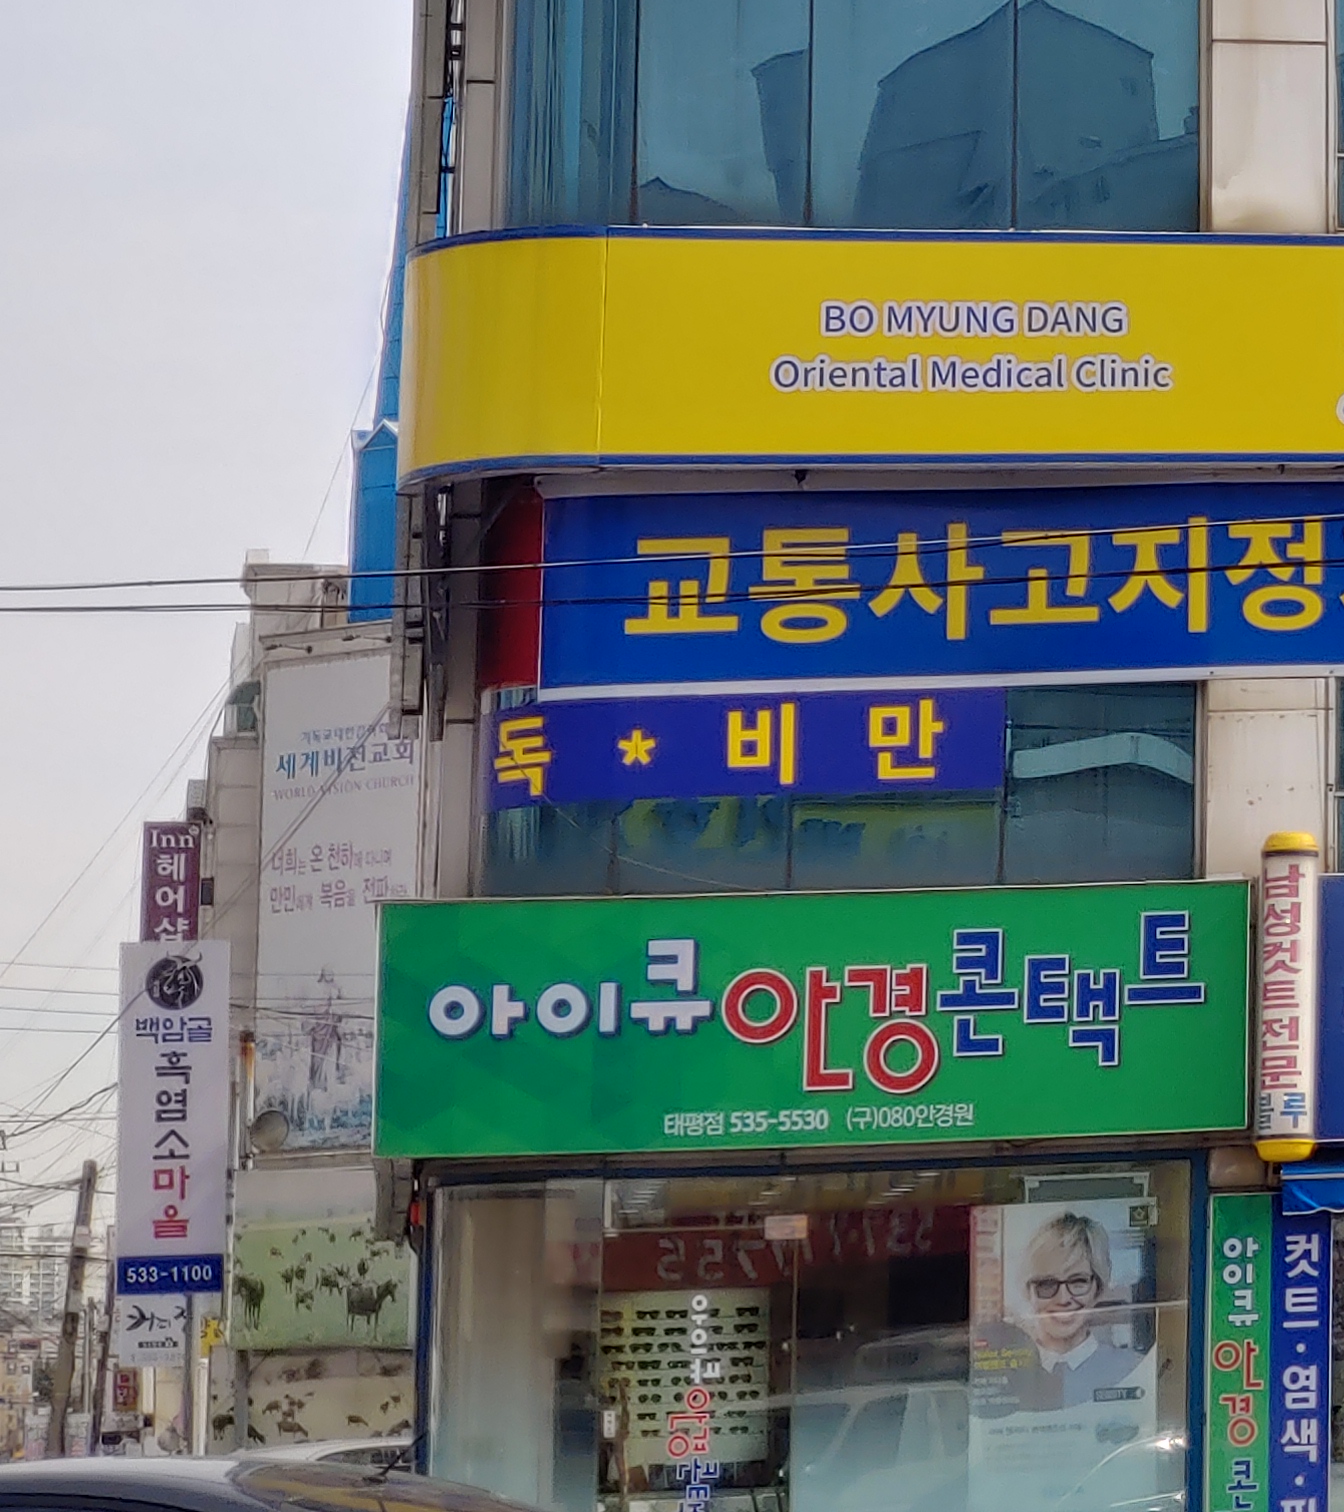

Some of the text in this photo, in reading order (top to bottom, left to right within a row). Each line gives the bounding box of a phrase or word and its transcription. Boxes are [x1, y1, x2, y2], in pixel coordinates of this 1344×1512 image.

[822, 303, 1126, 336] BO MYUNG DANG
[772, 357, 1173, 390] Oriental Medical Clinic
[276, 739, 414, 780] 세계비전교회
[151, 828, 194, 848] Inn
[136, 1016, 213, 1045] 백암골
[663, 1111, 725, 1138] 태평점
[729, 1108, 829, 1134] 535-5530
[126, 1265, 213, 1284] 533-1100
[1223, 1236, 1259, 1328] 아이큐
[1211, 1338, 1265, 1448] 안경
